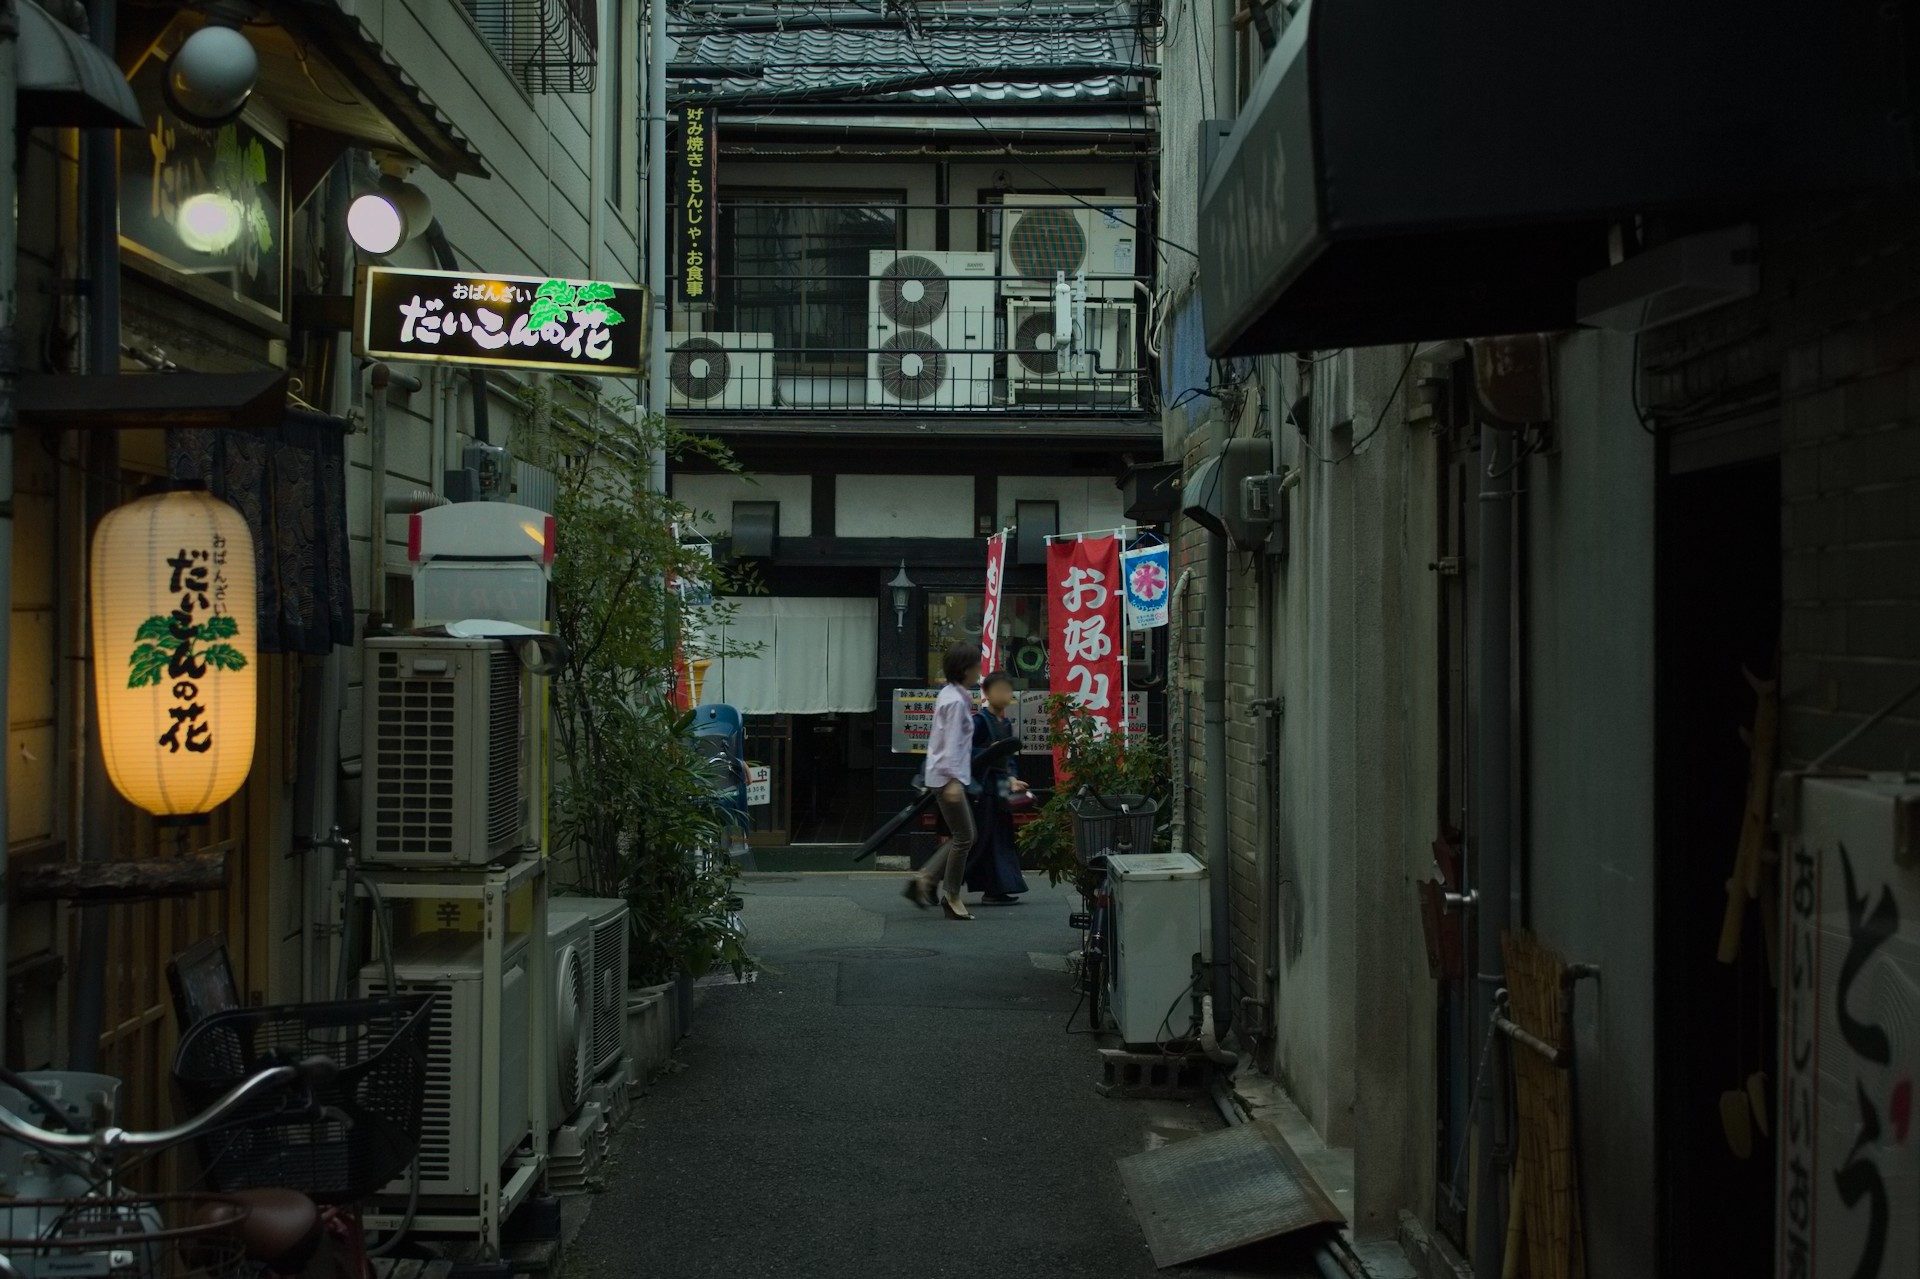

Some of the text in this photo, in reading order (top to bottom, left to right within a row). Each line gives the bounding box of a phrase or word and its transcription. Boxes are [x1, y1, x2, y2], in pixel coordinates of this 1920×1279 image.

[399, 295, 613, 360] だいこんの花
[452, 282, 532, 303] おばんざい
[212, 532, 227, 616] おばんざい
[158, 548, 212, 753] だいこんの花
